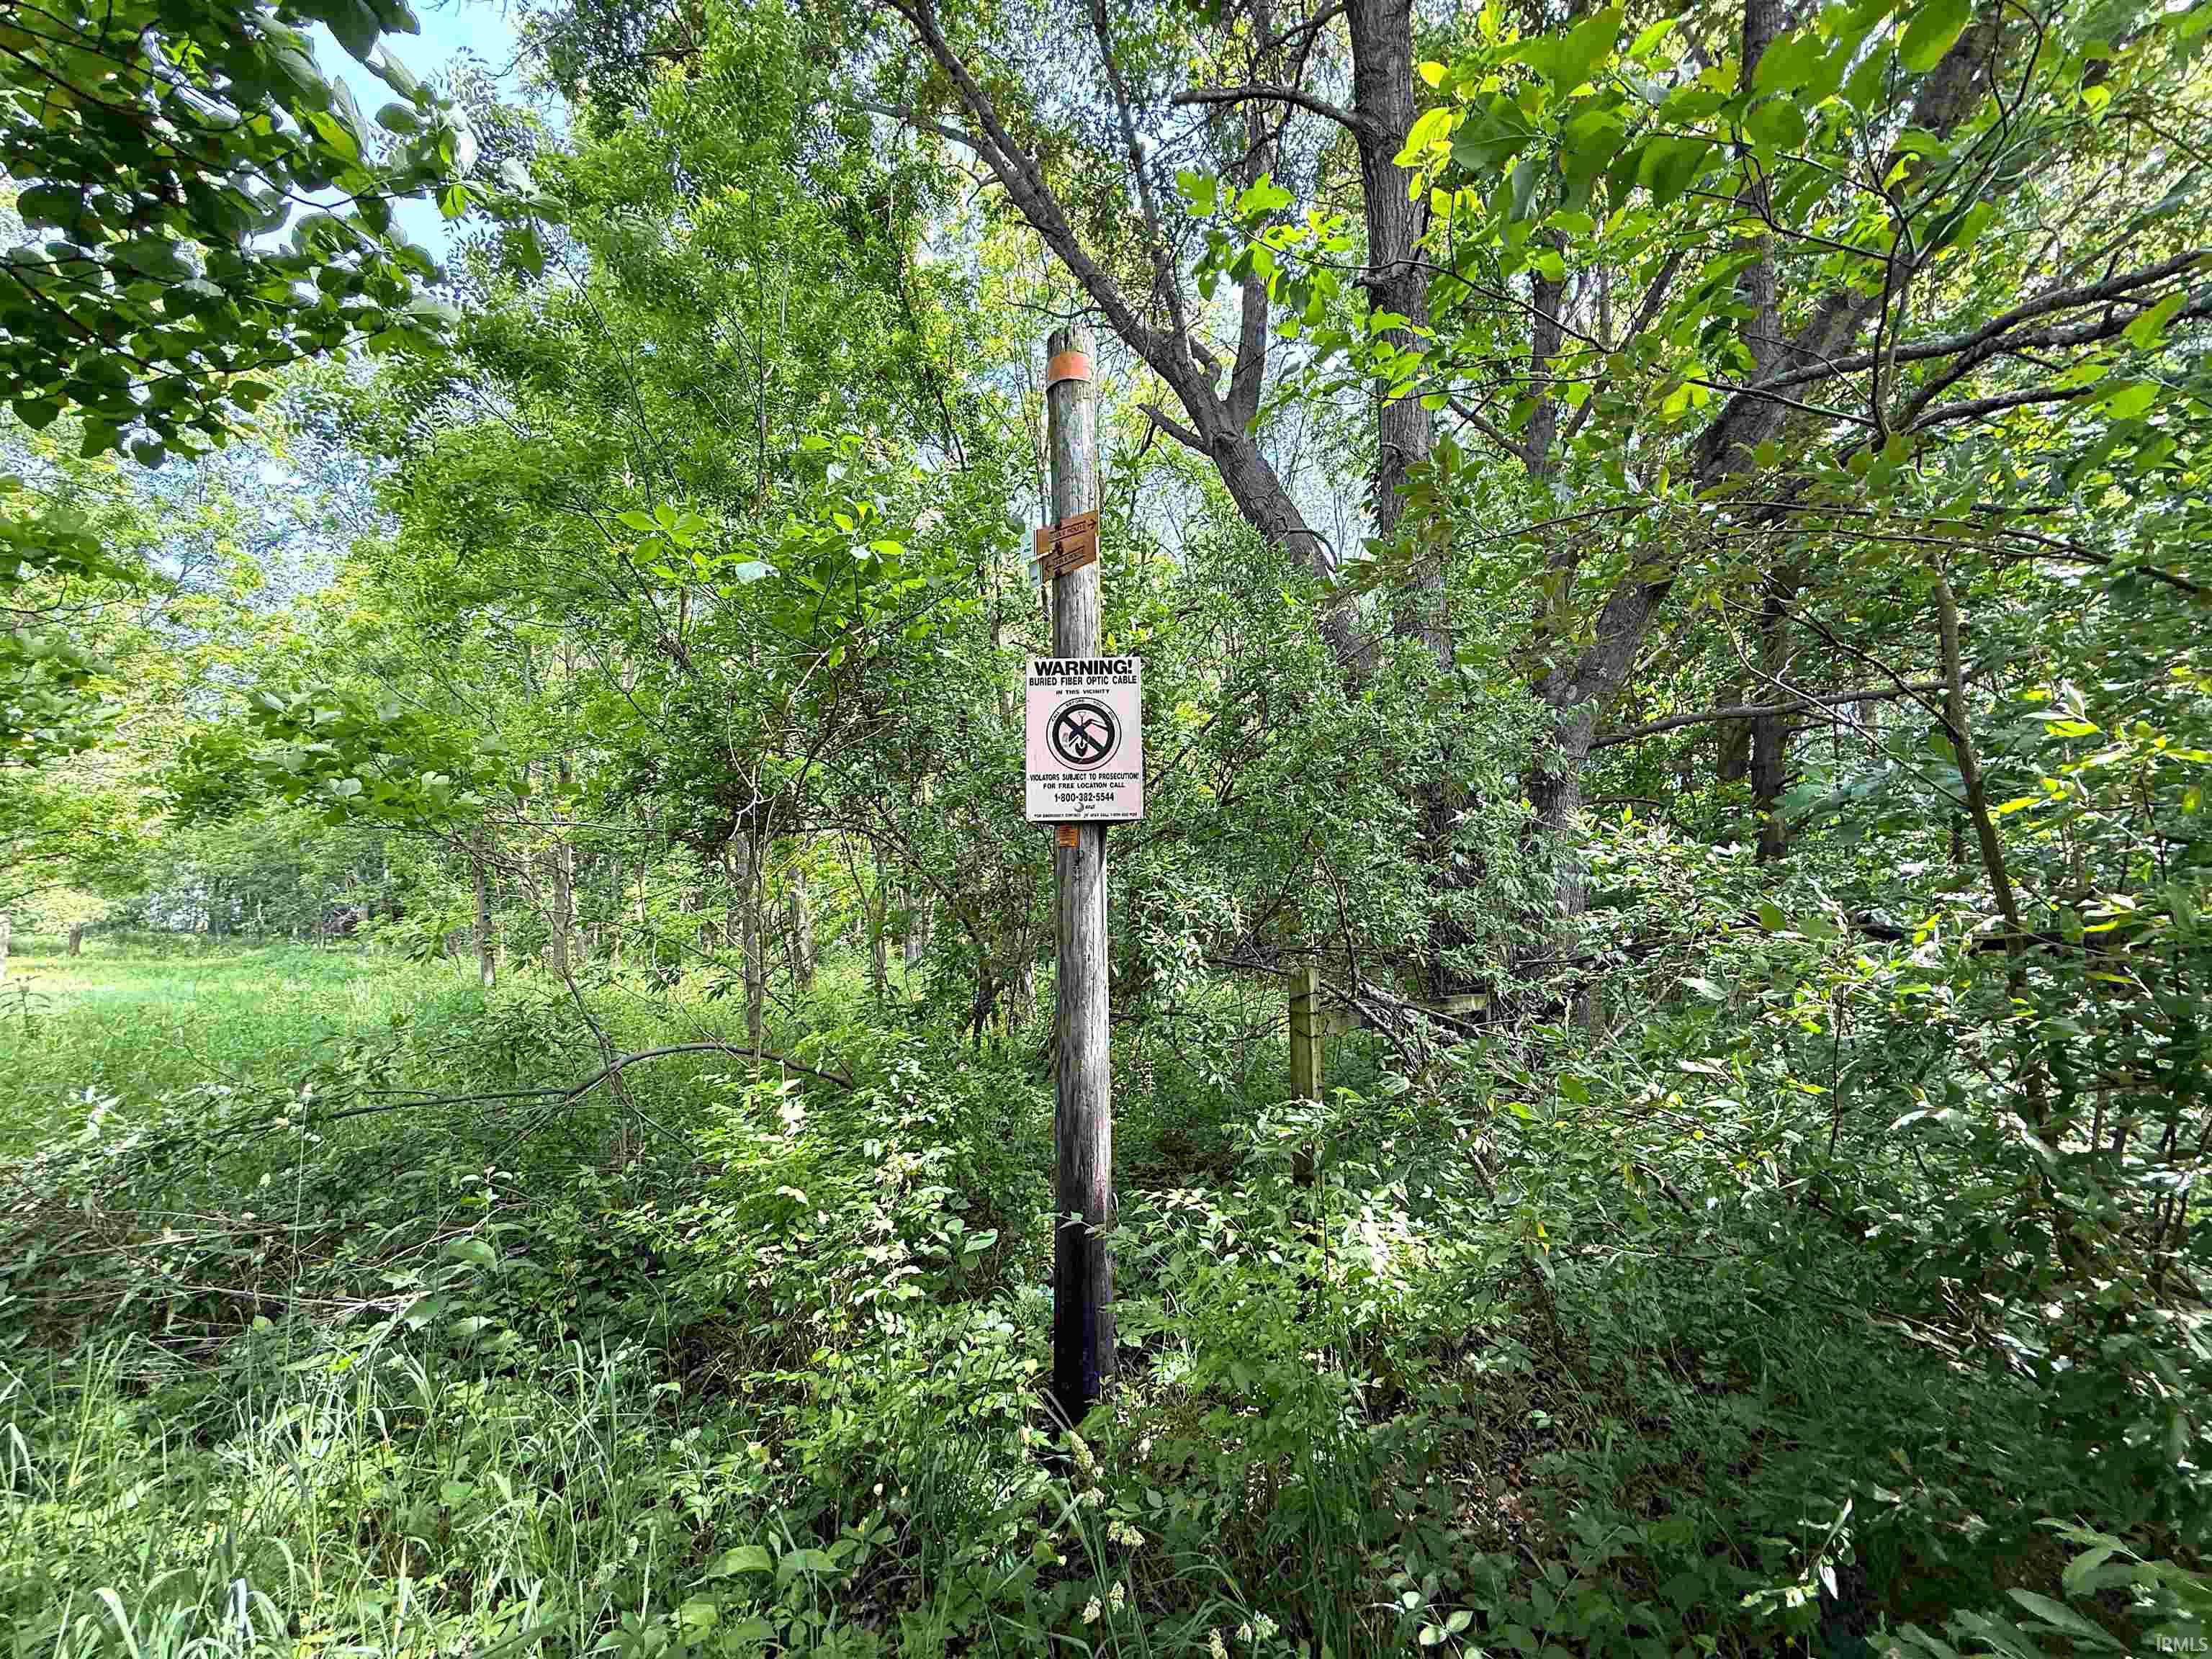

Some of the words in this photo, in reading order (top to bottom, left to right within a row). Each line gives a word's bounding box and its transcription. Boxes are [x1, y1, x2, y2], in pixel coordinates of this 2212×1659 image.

[1034, 660, 1133, 675] WARNING!
[1029, 677, 1057, 686] BURIED
[1061, 677, 1083, 685] FIBER
[1086, 676, 1109, 685] OPTIC
[1112, 675, 1137, 684] CABLE
